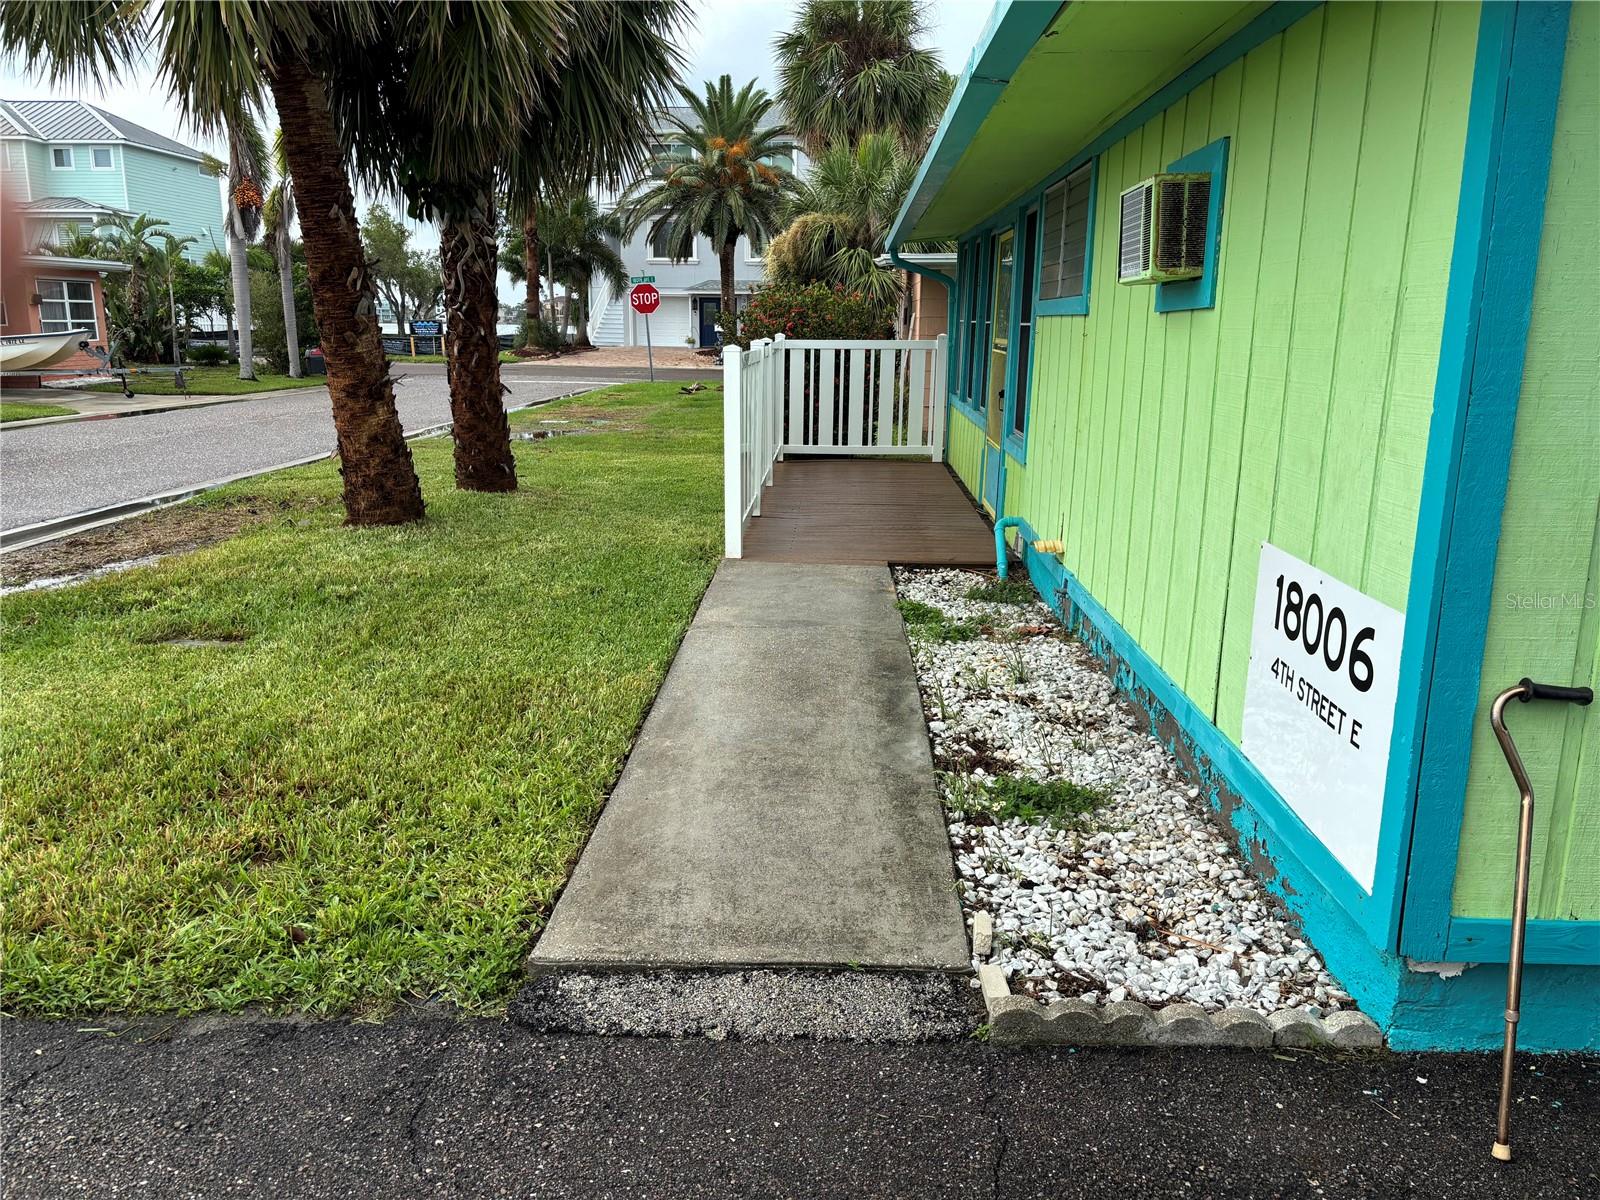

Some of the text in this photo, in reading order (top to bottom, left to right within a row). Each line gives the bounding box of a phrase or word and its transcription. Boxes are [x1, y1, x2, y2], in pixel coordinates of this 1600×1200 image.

[632, 292, 658, 305] STOP
[1274, 574, 1376, 693] 18006
[1270, 657, 1363, 750] 4TH STREET E
